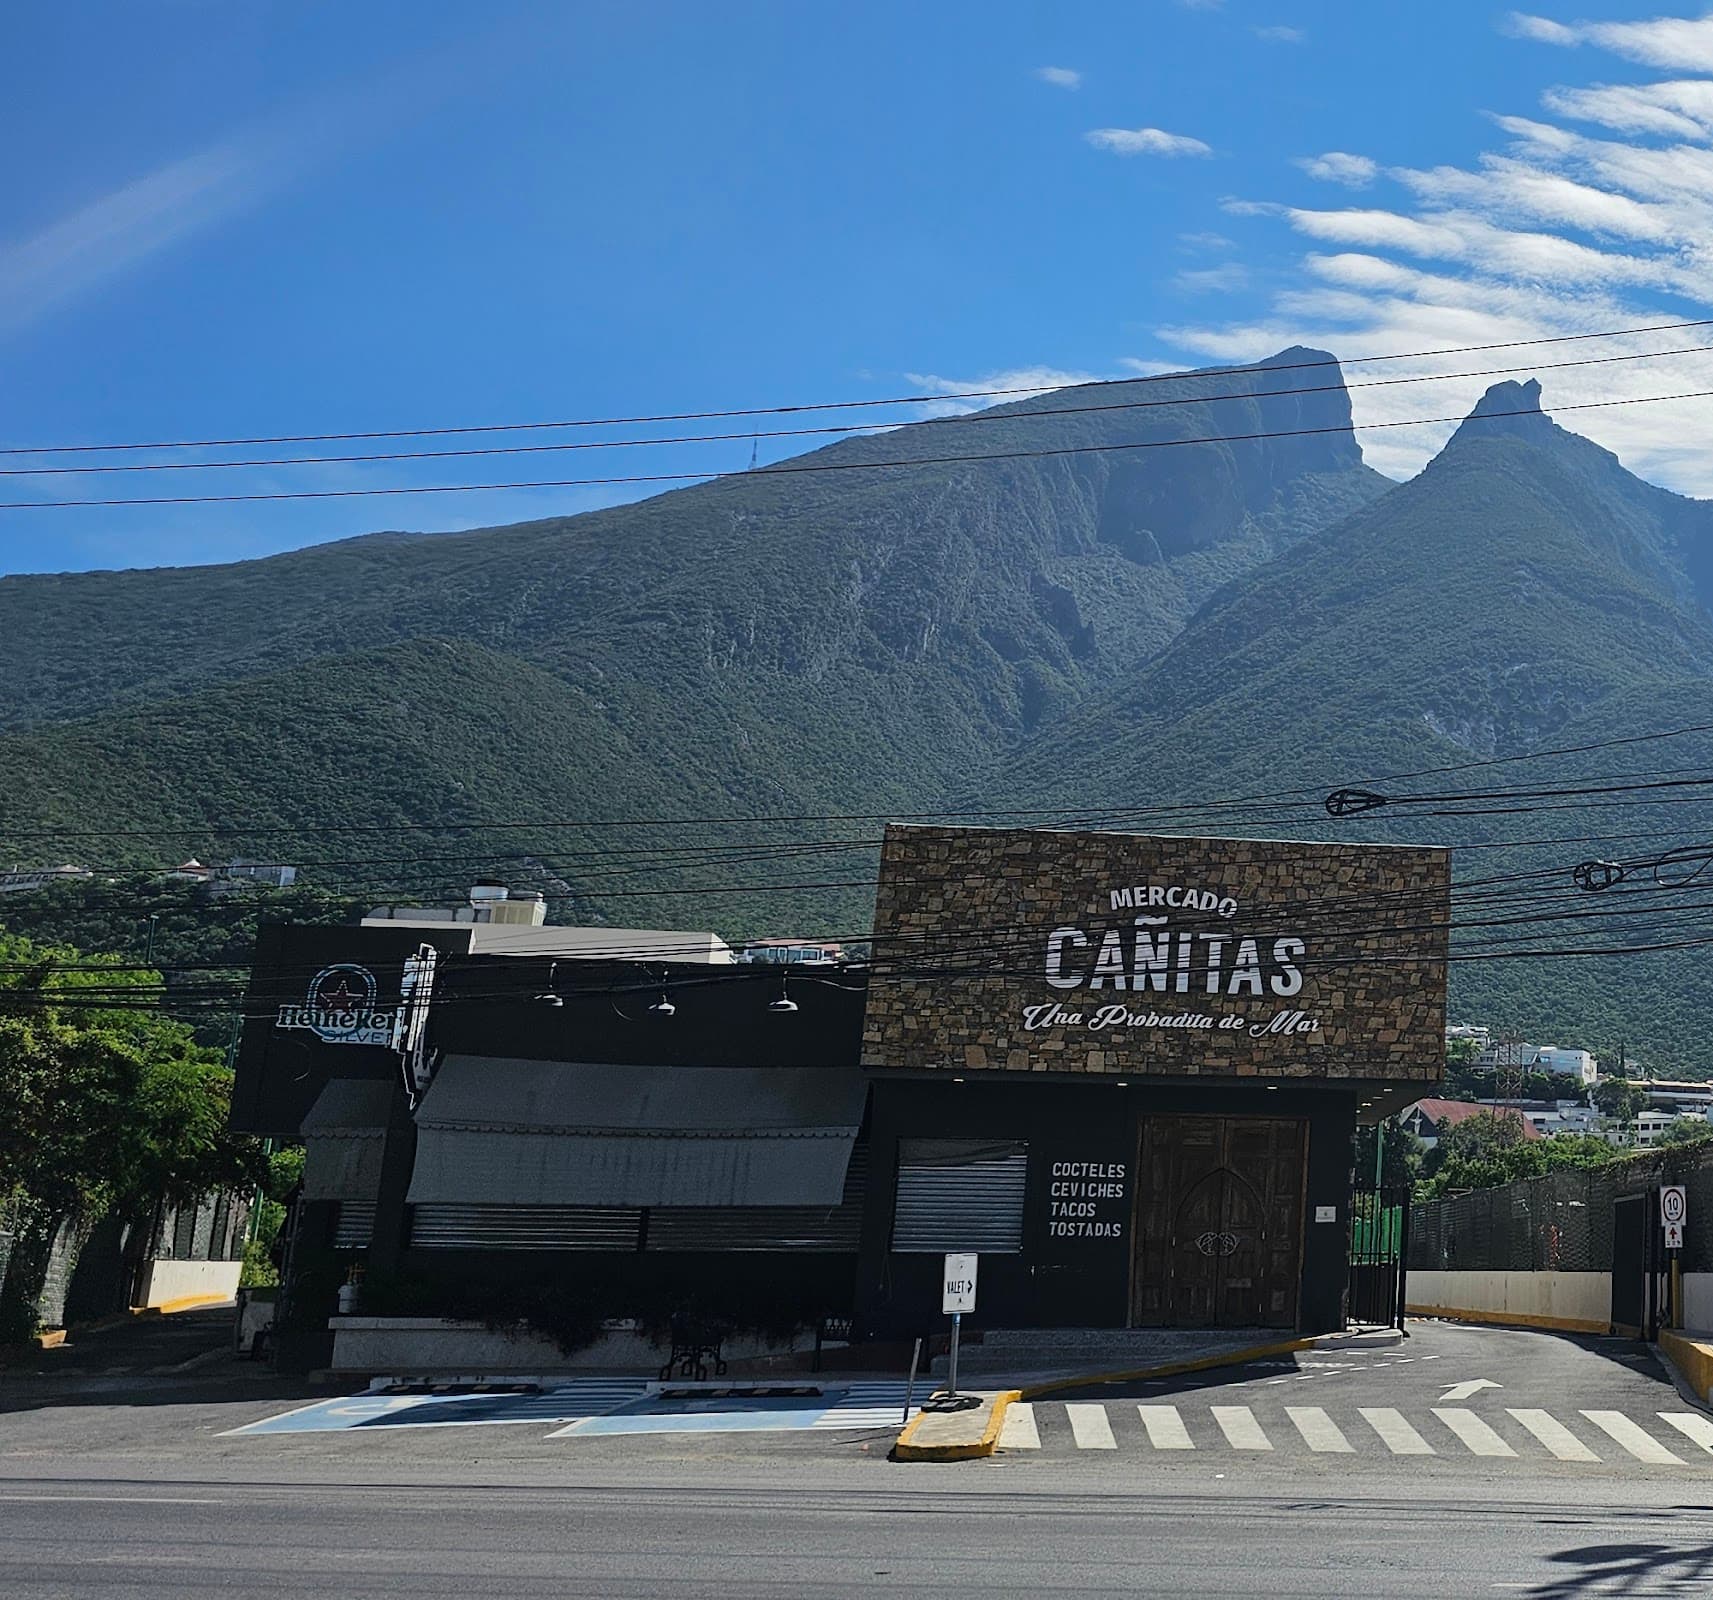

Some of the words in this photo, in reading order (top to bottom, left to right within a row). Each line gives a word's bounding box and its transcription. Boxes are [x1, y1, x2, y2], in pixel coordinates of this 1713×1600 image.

[1109, 885, 1239, 919] MERCADO
[1044, 914, 1306, 997] CAÑITAS
[1021, 1002, 1083, 1032] Una
[1087, 1003, 1215, 1031] Probadita
[1218, 1013, 1245, 1030] de
[1248, 1008, 1320, 1039] Mar
[1052, 1162, 1126, 1179] COCTELES
[1050, 1181, 1124, 1198] CEVICHES
[1050, 1201, 1097, 1218] TACOS
[1668, 1197, 1679, 1210] 10
[1049, 1221, 1122, 1238] TOSTADAS
